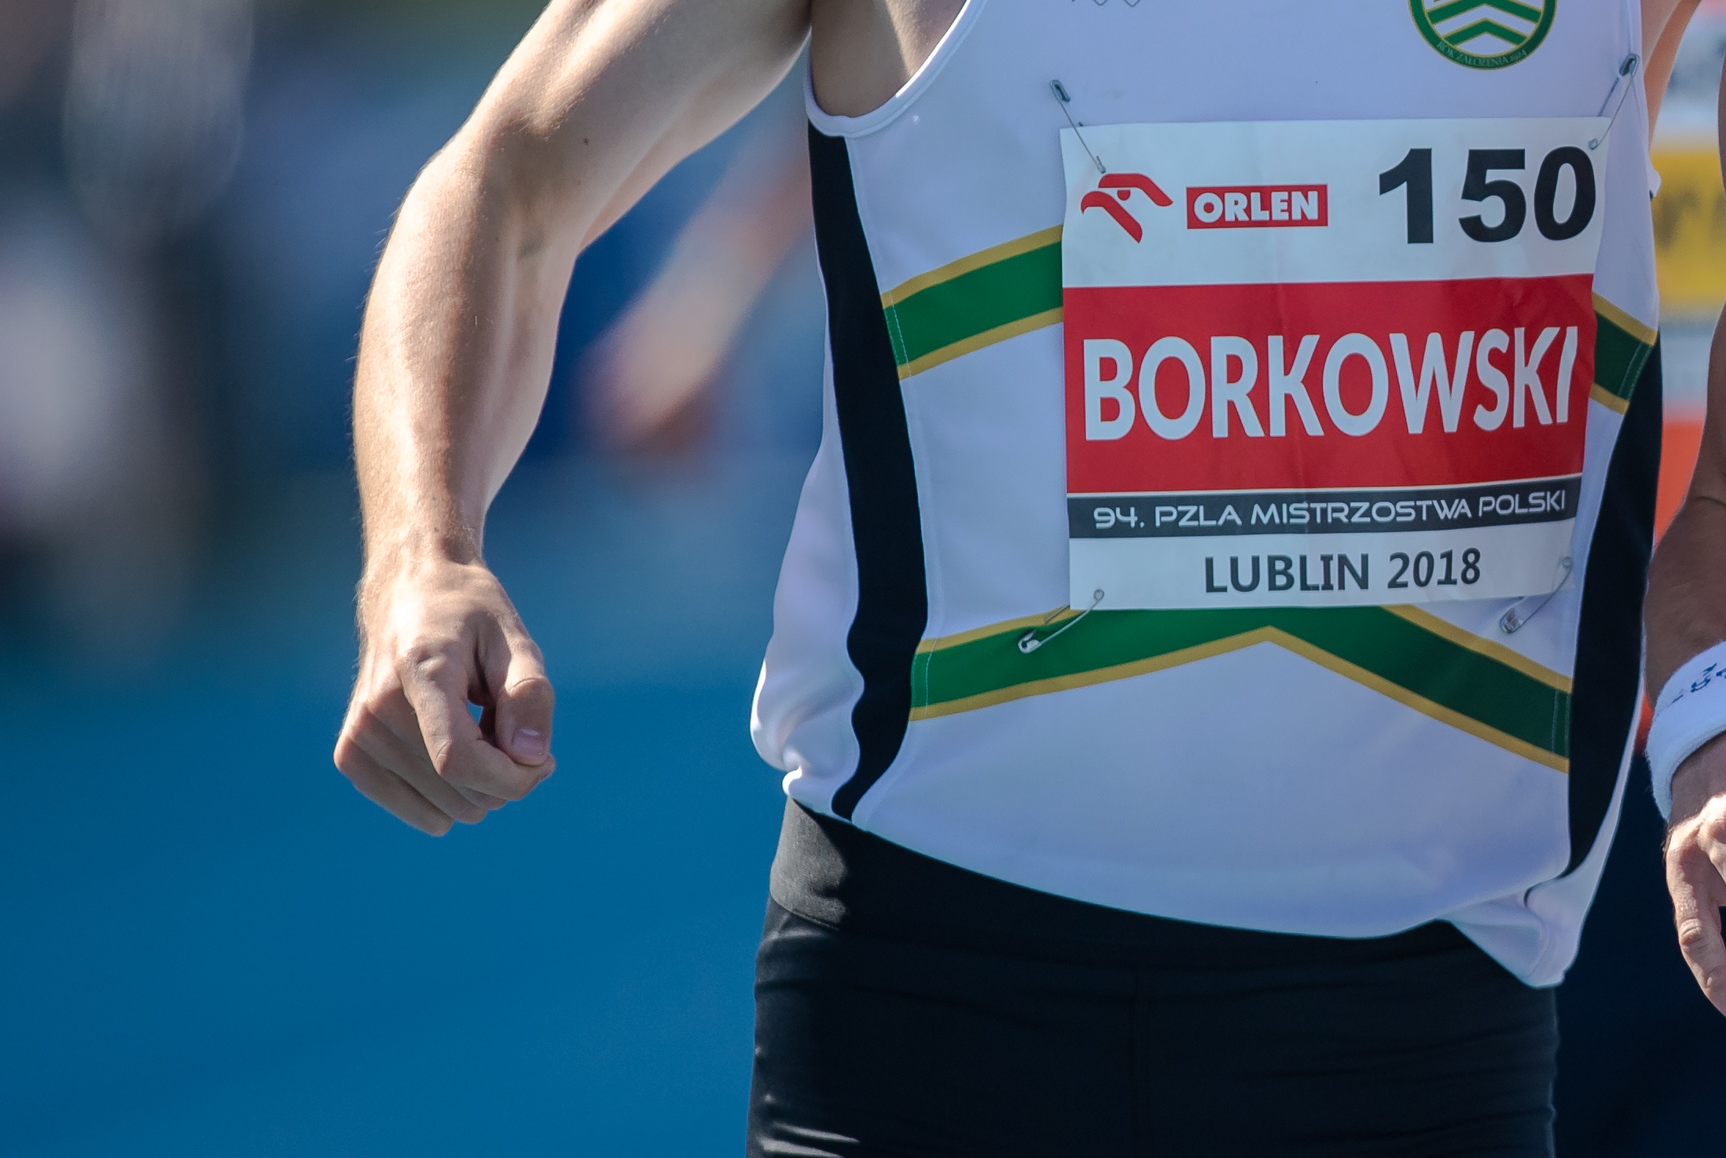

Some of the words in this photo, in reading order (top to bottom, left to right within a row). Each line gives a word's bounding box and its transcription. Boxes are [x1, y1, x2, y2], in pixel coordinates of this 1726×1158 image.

[1193, 190, 1319, 223] ORLEN
[1379, 146, 1597, 245] 150
[1083, 326, 1578, 441] BORKOWSKI
[1093, 506, 1145, 530] 94.
[1155, 504, 1242, 528] PZLA
[1250, 498, 1471, 525] MISTRZOSTWA
[1478, 489, 1566, 517] POLSKI
[1204, 552, 1369, 594] LUBLIN
[1387, 548, 1481, 590] 2018
